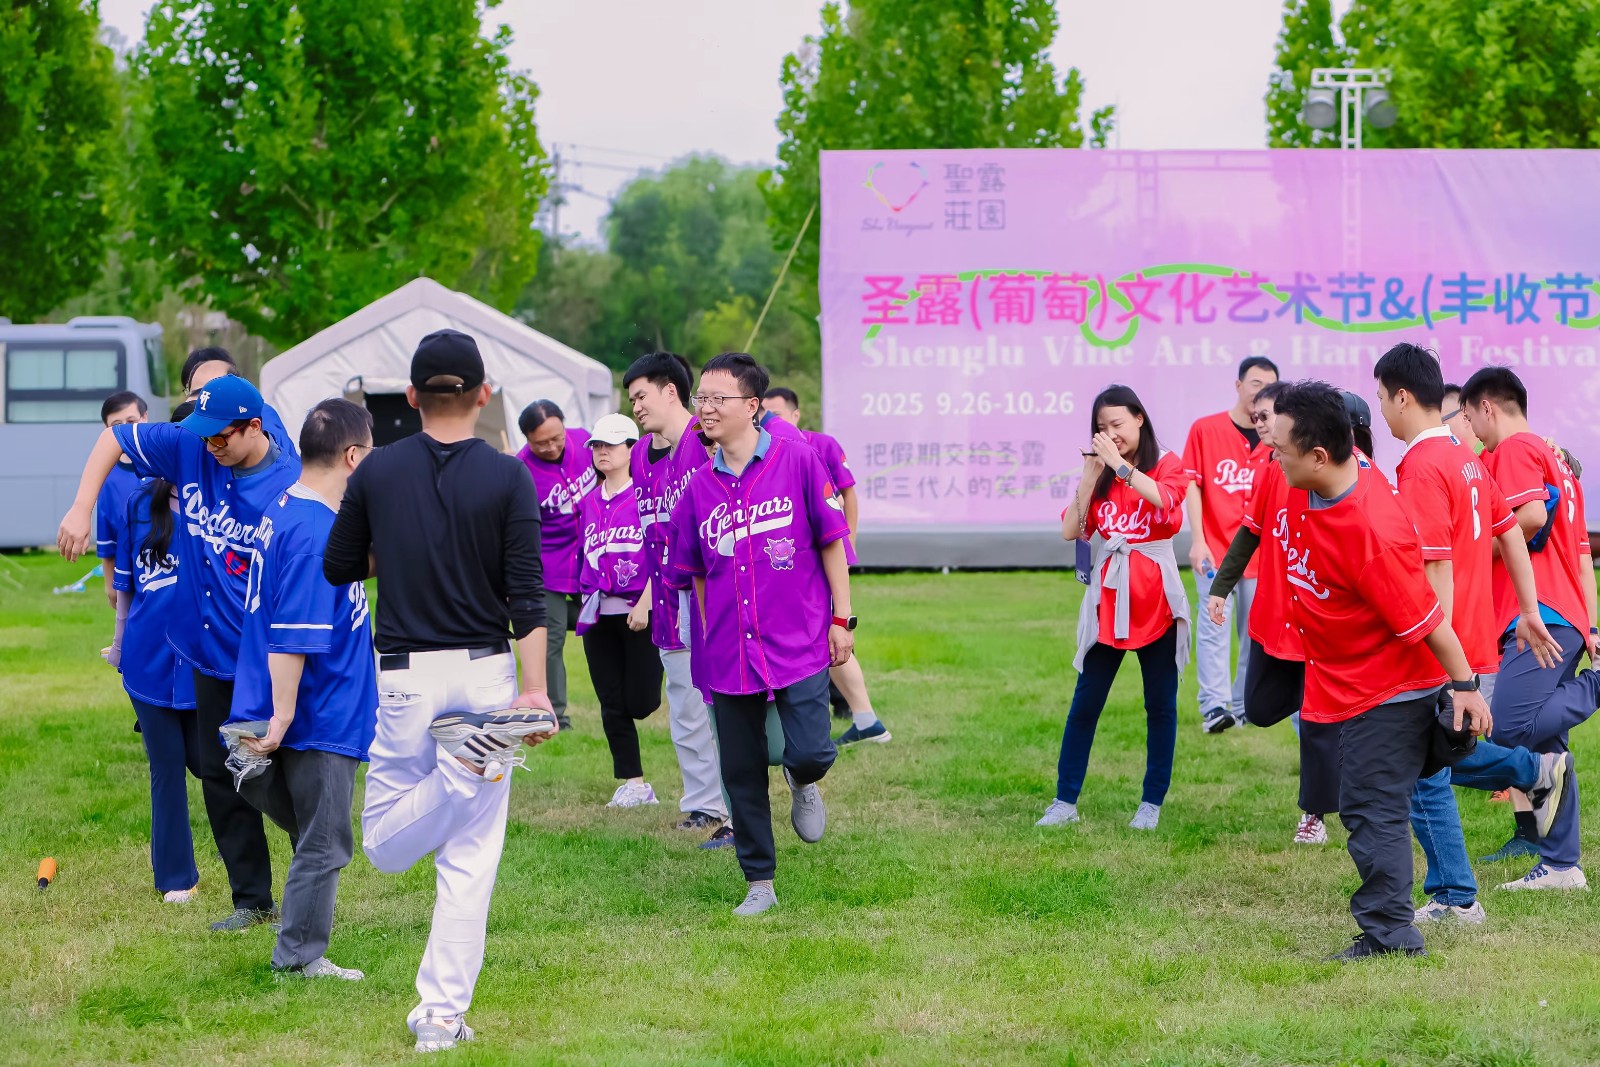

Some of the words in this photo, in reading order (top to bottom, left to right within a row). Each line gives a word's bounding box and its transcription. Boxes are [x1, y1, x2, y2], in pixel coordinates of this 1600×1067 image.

[861, 335, 1024, 376] Shenglu
[1042, 335, 1134, 366] Vine
[1150, 337, 1233, 366] Arts
[861, 393, 924, 416] 2025
[937, 391, 1074, 415] 9.26-10.26
[865, 441, 1046, 467] 把假期交给圣露
[865, 474, 1083, 501] 把三代人的笑声留
[699, 496, 793, 549] Gengars
[1098, 499, 1152, 537] Reds
